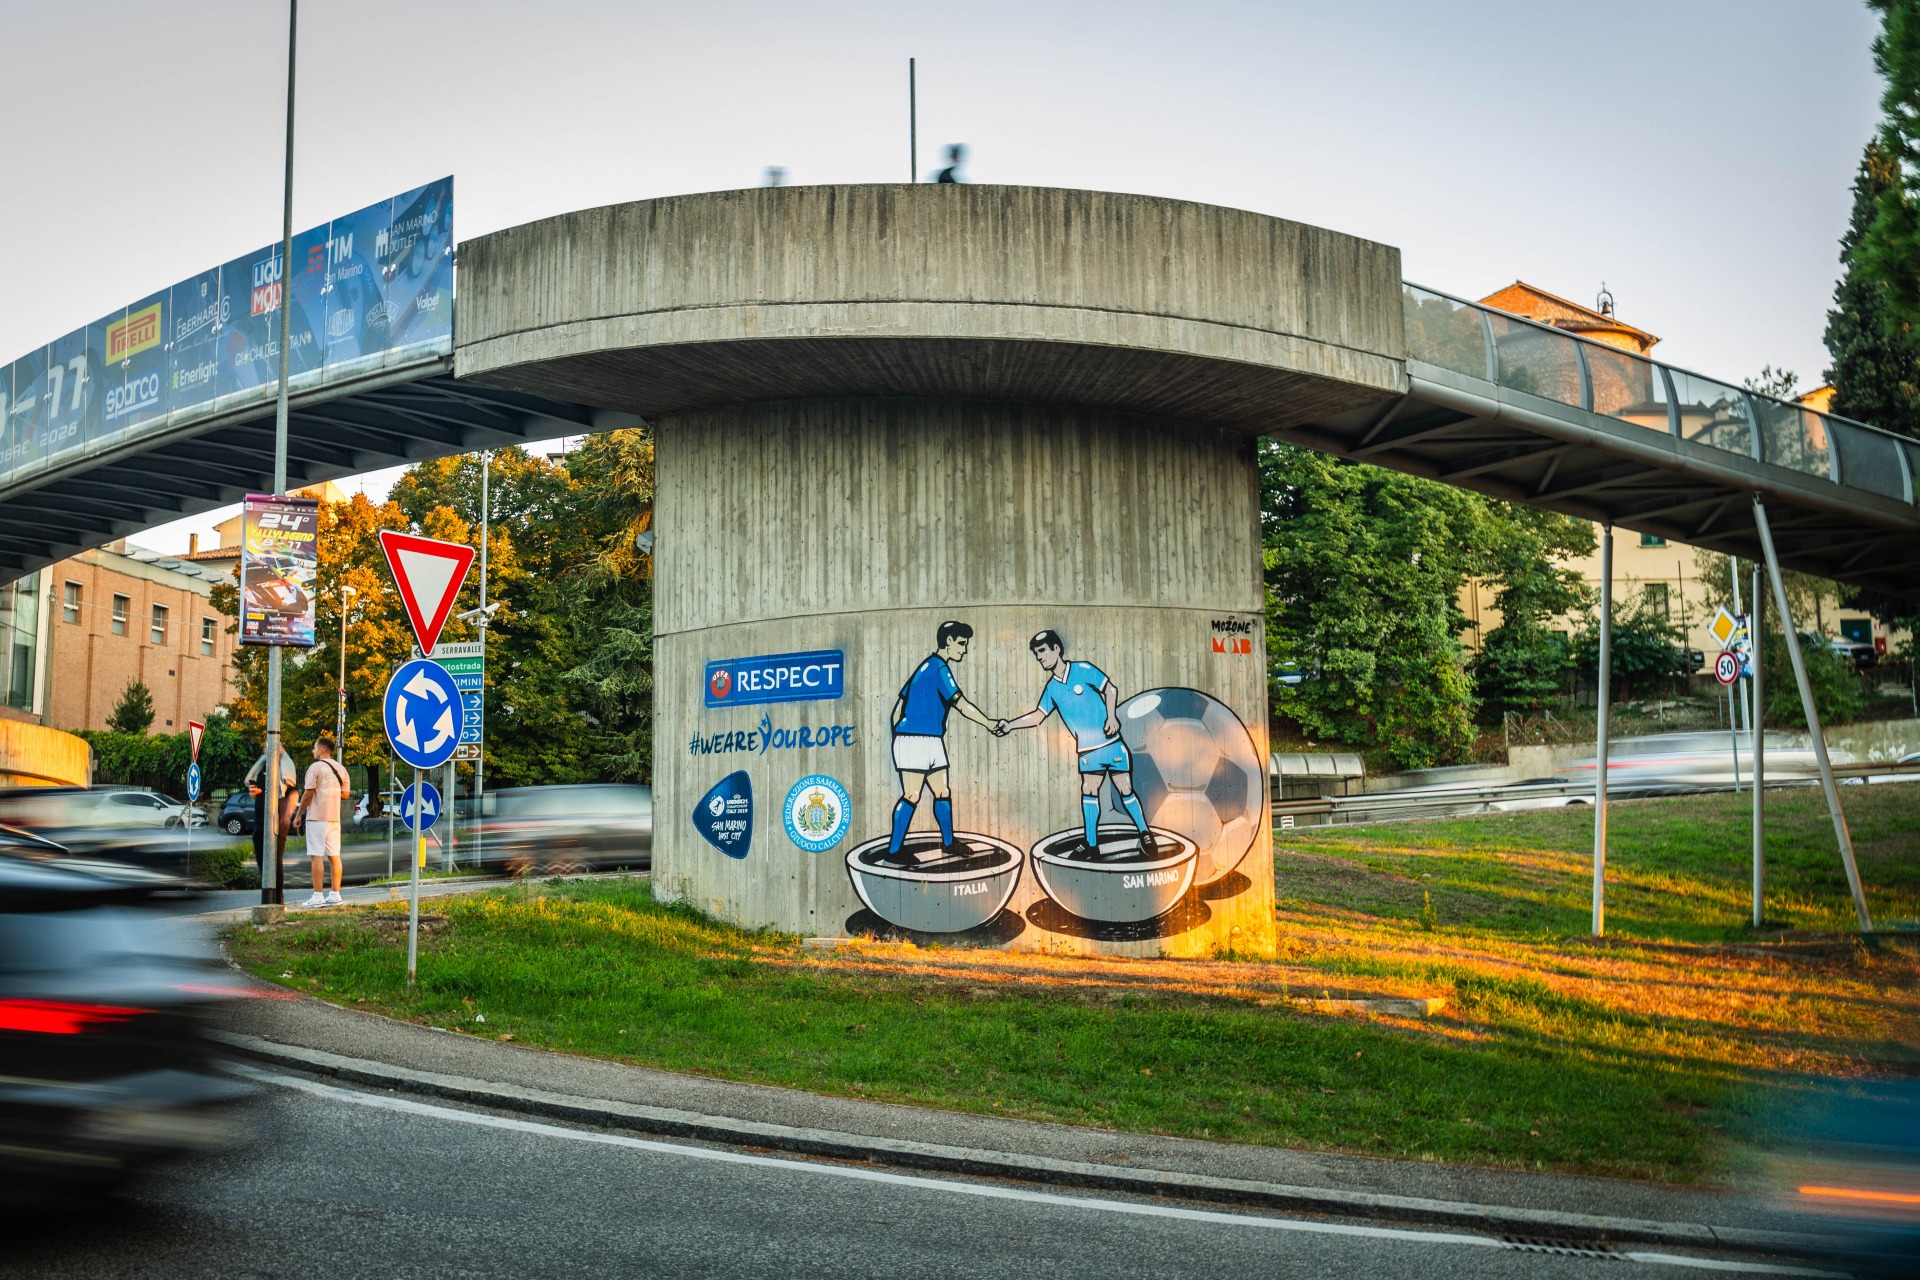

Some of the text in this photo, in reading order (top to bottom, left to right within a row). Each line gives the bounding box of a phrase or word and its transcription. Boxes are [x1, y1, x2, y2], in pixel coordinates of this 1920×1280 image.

[406, 210, 438, 230] MARINO
[325, 232, 353, 264] TIM
[389, 233, 418, 253] OUTLET
[254, 256, 283, 288] LIQU
[338, 263, 363, 281] Marino
[110, 312, 156, 357] PIRELLI
[180, 360, 218, 386] Enerlight
[106, 373, 158, 419] sparco
[40, 421, 78, 448] 2026
[442, 645, 482, 655] SERRAVALLE
[443, 662, 481, 671] utostrada
[712, 670, 729, 681] UEFA
[1720, 660, 1733, 676] 50
[738, 664, 839, 692] RESPECT
[785, 777, 850, 825] FEDERAZIONE SAMMARINESE
[711, 819, 747, 832] SAN MARINO
[731, 831, 742, 840] CITY
[790, 830, 817, 851] GIUOCO
[818, 829, 844, 850] CALCIO
[953, 881, 988, 896] ITALIA
[1123, 870, 1178, 889] SAN MARINO
